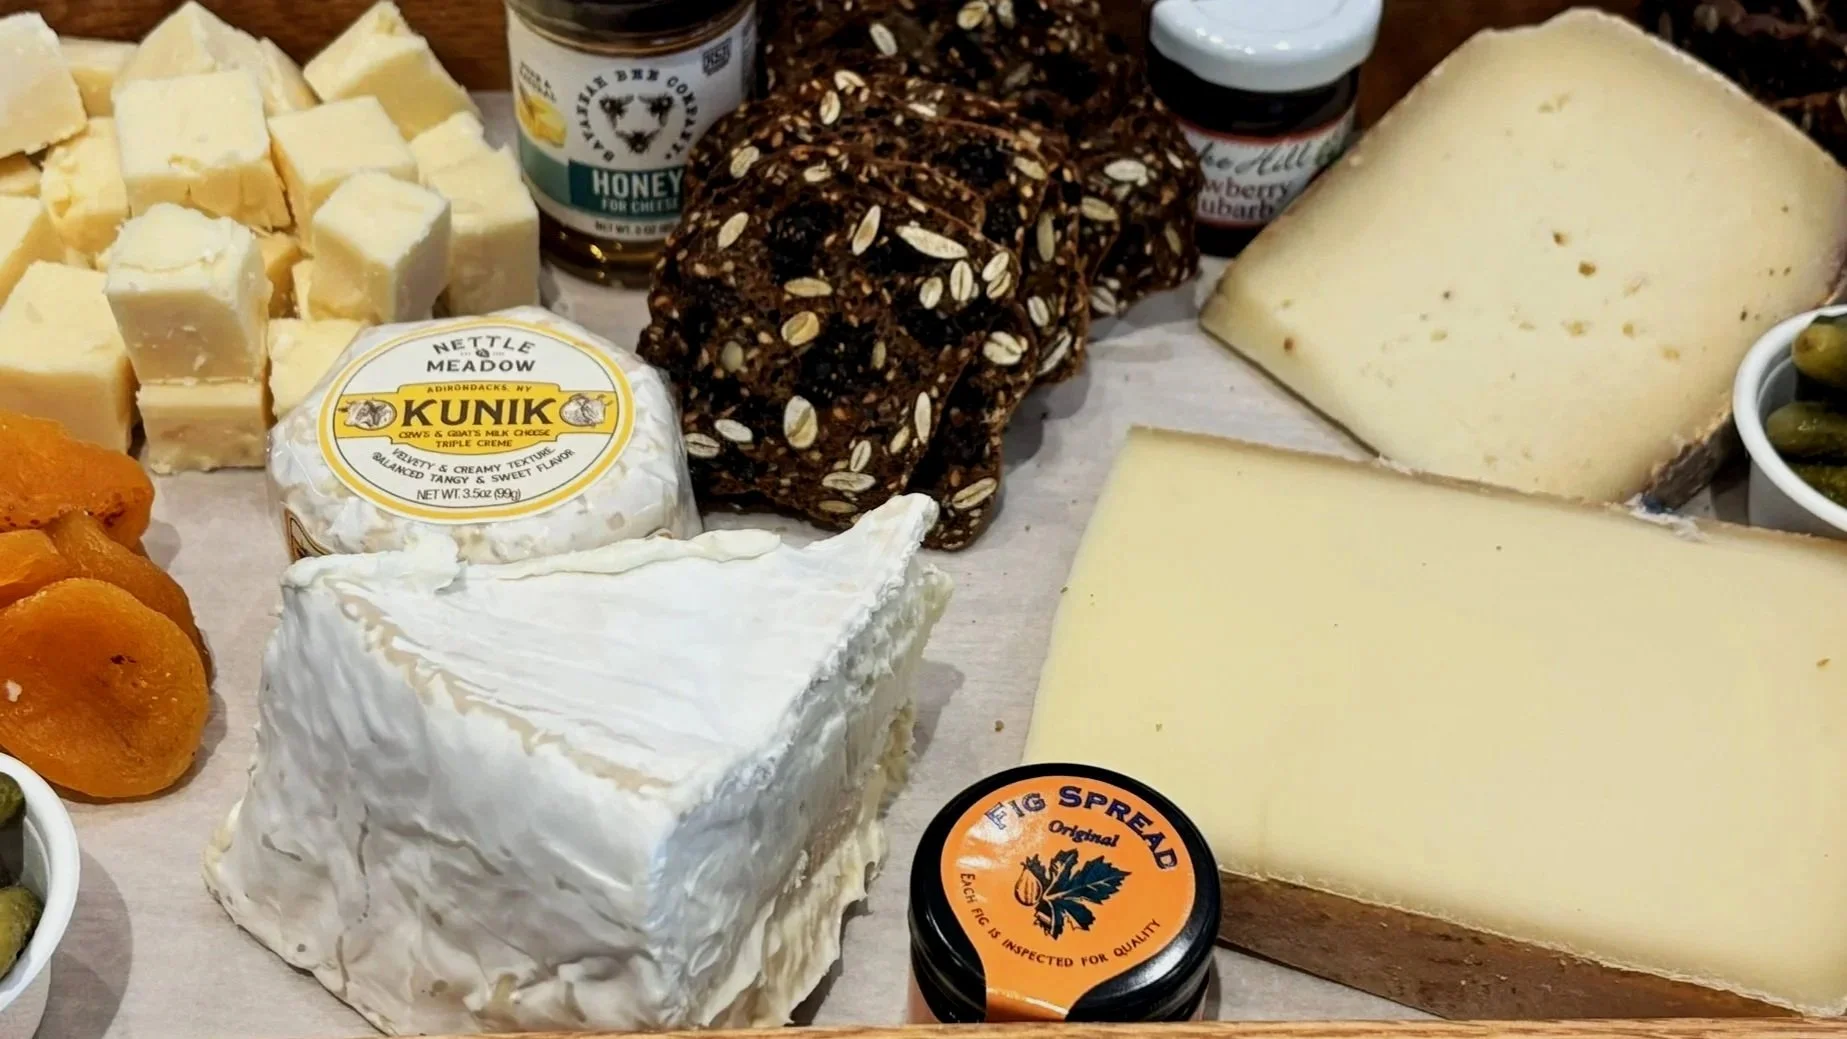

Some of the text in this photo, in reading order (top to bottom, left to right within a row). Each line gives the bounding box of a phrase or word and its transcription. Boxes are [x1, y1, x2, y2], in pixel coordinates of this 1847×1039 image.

[616, 68, 659, 81] BEE
[667, 76, 698, 154] COMPANY
[592, 168, 683, 198] HONEY
[1203, 177, 1290, 202] wberry
[602, 199, 627, 213] FOR
[1201, 197, 1274, 220] ubarb
[432, 335, 536, 354] NETTLE
[426, 359, 536, 373] MEADOW
[516, 385, 533, 393] NY
[401, 398, 556, 427] KUNIK
[434, 430, 443, 438] &
[485, 429, 509, 437] MILK
[435, 439, 513, 448] TRIPLE CREME
[372, 449, 575, 485] BALANCED TANGY & SWEET FLAVOR
[392, 446, 556, 474] VELVETY & CREAMY TEXTURE
[416, 489, 440, 500] NET
[462, 488, 492, 499] 3.5oz
[493, 488, 521, 501] (99g)
[985, 786, 1179, 871] FIG SPREAD
[1048, 820, 1120, 848] Original
[960, 873, 1161, 967] EACH FIG IS INSPECTED FOR QUALITY
